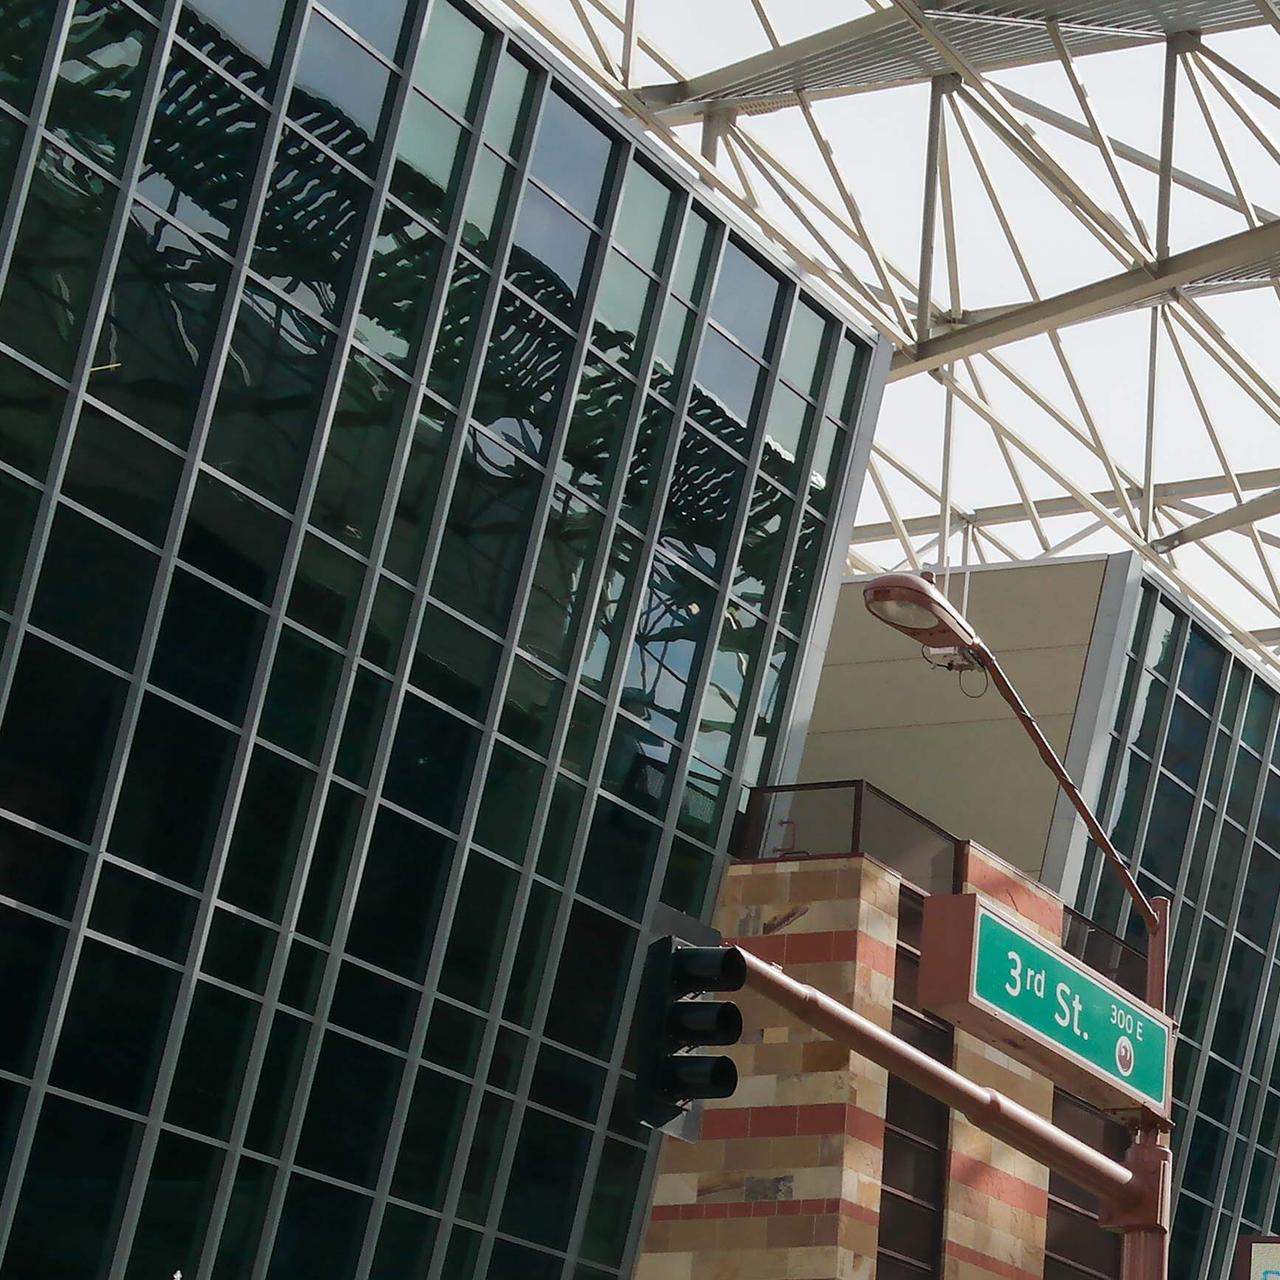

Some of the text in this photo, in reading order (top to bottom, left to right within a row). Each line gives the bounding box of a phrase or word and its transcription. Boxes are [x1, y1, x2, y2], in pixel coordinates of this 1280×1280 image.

[1005, 951, 1089, 1041] 3rd St.
[1110, 1004, 1143, 1042] 300 E
